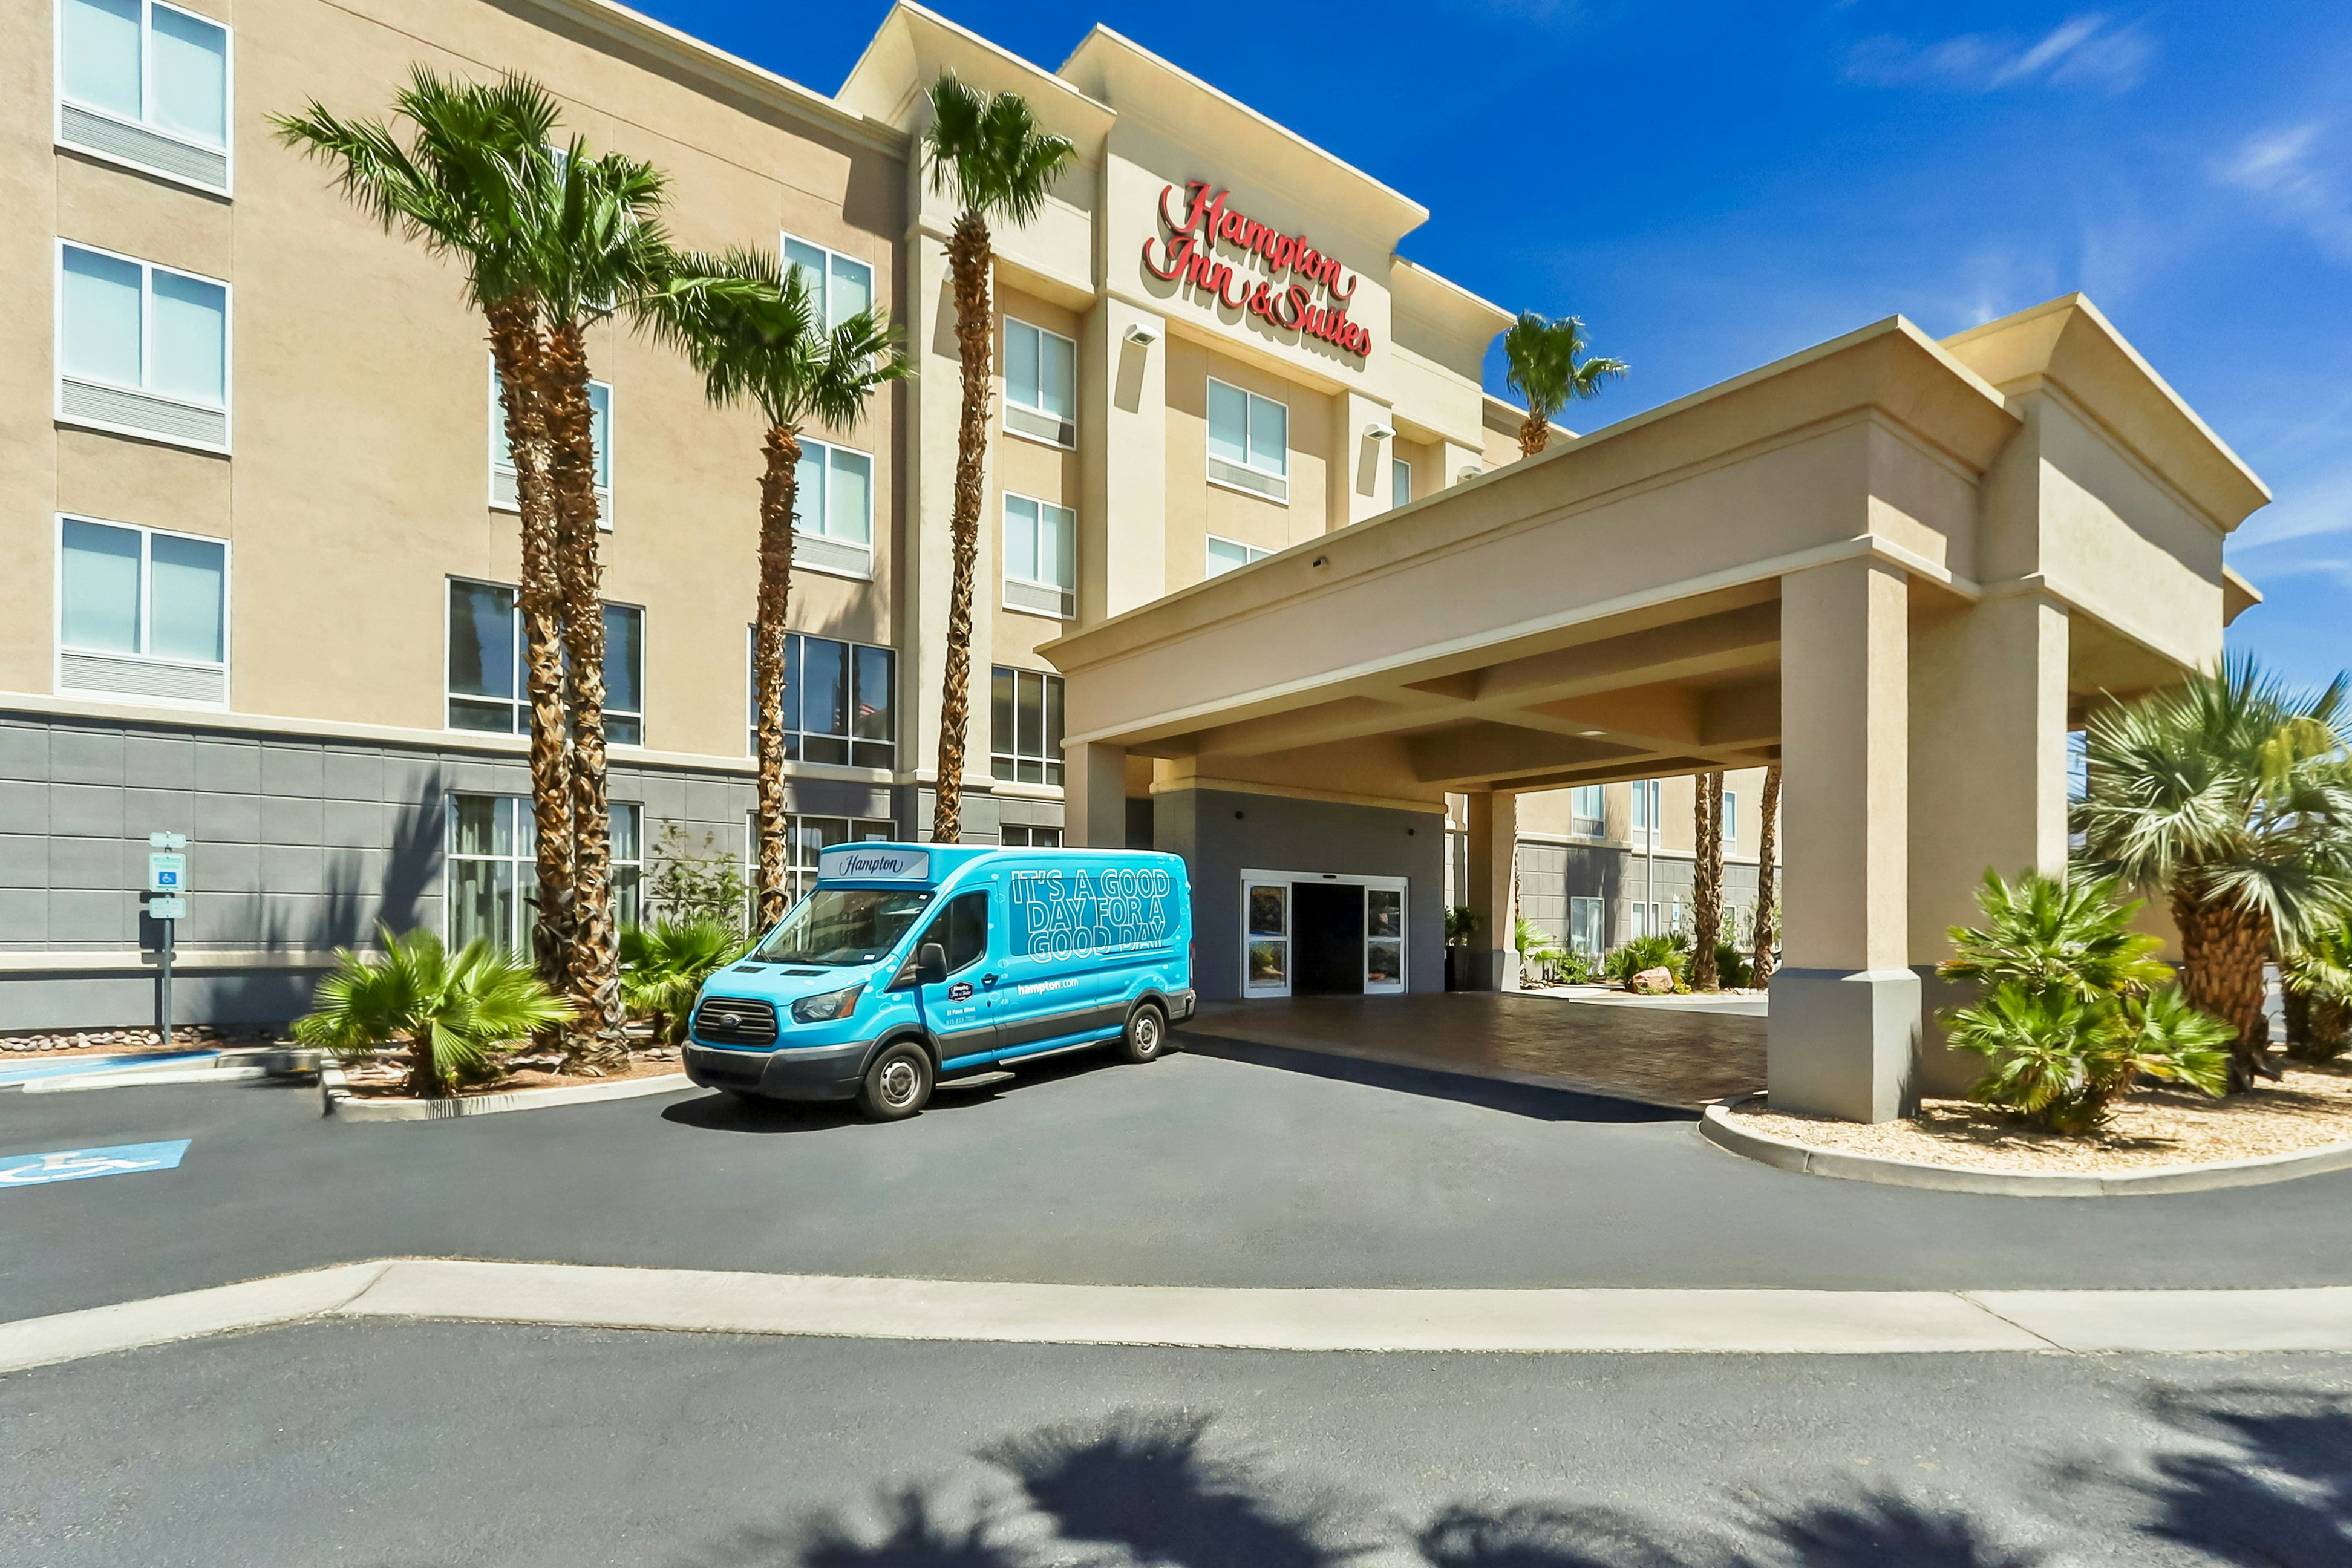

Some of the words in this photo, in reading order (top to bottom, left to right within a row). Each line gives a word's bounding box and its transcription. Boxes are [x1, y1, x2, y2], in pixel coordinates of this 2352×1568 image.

[1158, 180, 1357, 300] Hampton
[1142, 235, 1251, 308] Inn
[1247, 281, 1278, 327] &
[1271, 284, 1371, 357] Suites
[839, 854, 903, 876] Hampton
[1011, 869, 1065, 904] IT'S
[1074, 869, 1096, 900] A
[1100, 868, 1170, 899] GOOD
[1026, 898, 1086, 933] DAY
[1094, 897, 1143, 927] FOR
[1149, 895, 1166, 923] A
[1028, 926, 1111, 963] GOOD
[1119, 921, 1166, 952] DAY
[1018, 978, 1079, 995] hampton.com
